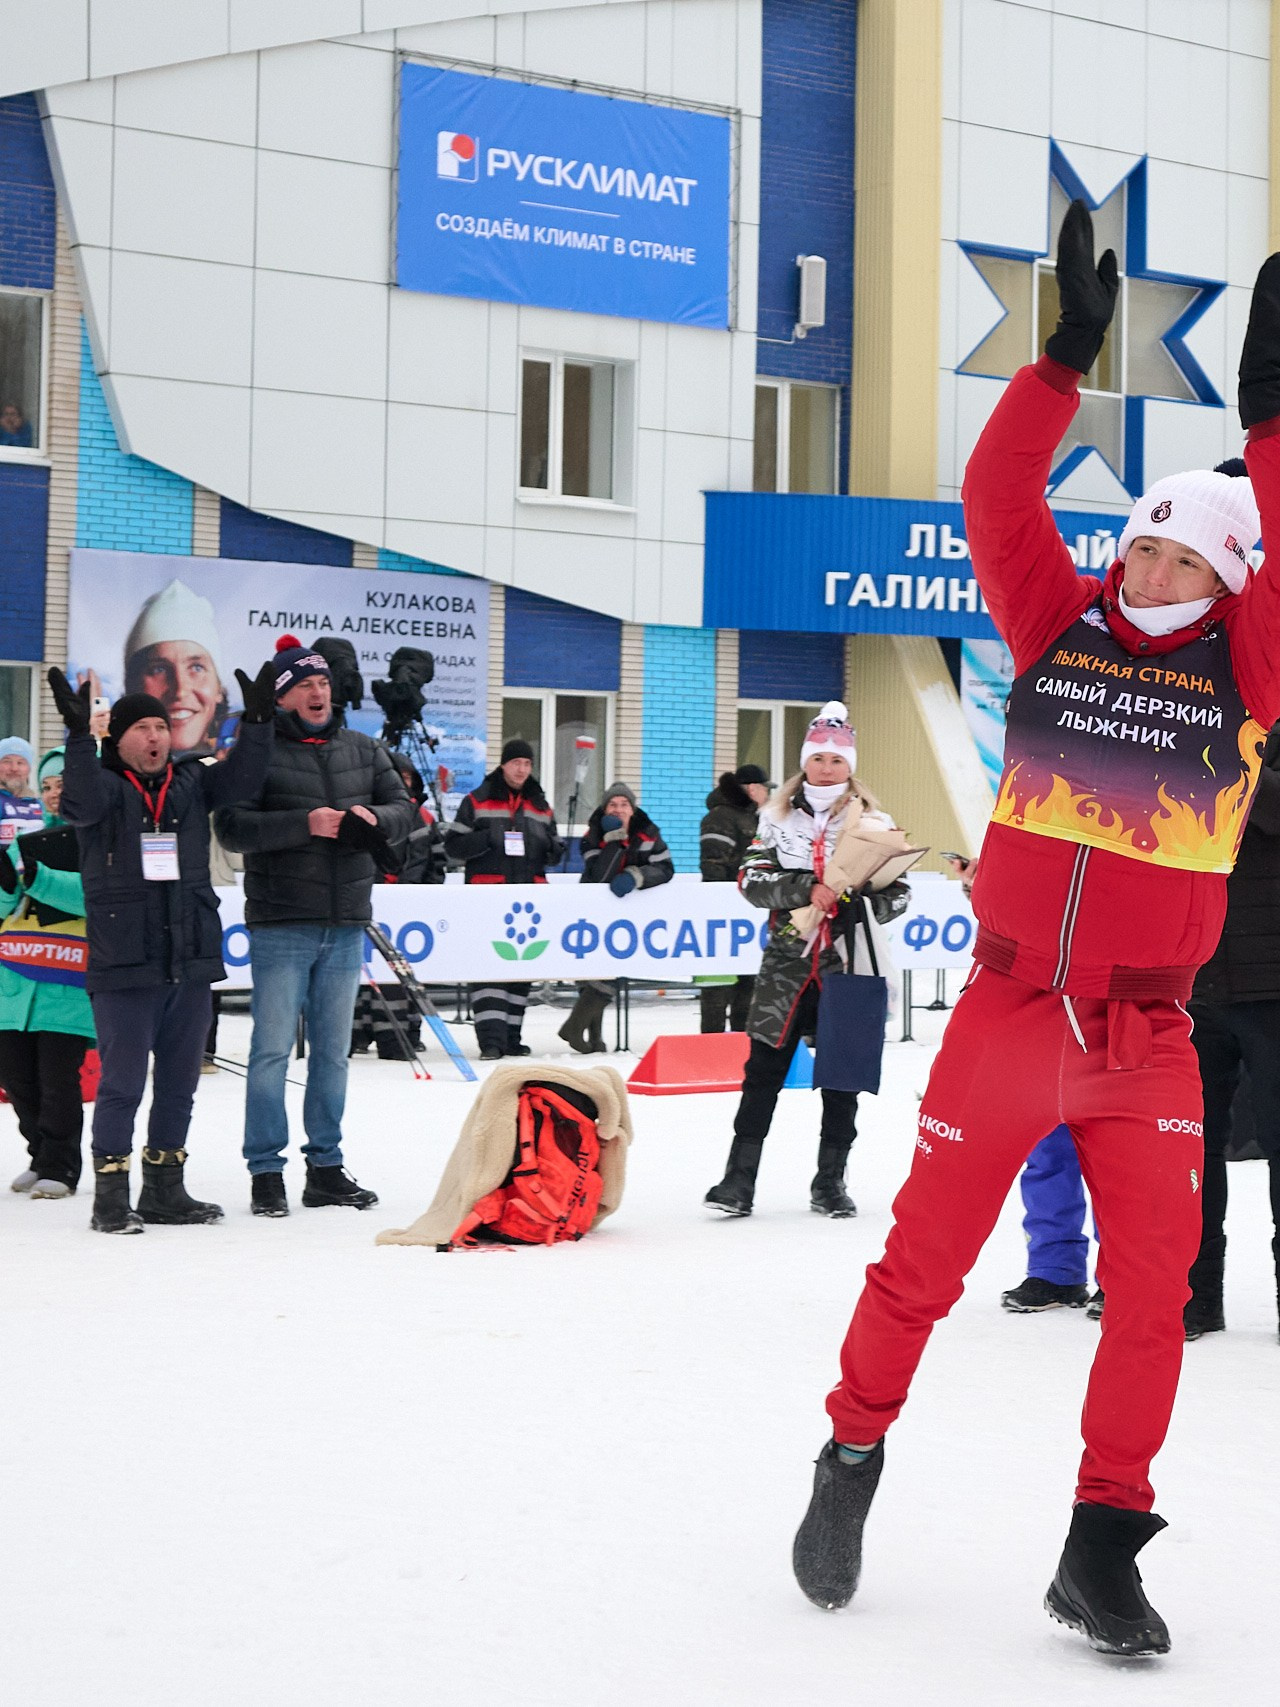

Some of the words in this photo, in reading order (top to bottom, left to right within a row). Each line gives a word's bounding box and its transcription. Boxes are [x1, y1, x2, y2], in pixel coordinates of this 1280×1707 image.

[486, 147, 698, 207] РУСКЛИМАТ
[435, 212, 530, 242] СОЗДАЁМ
[533, 227, 610, 253] КЛИМАТ
[613, 237, 627, 256] В
[629, 240, 697, 266] СТРАНЕ
[366, 591, 477, 614] КУЛАКОВА
[248, 610, 334, 632] ГАЛИНА
[340, 616, 477, 640] АЛЕКСЕЕВНА
[361, 651, 380, 663] НА
[384, 652, 476, 667] ОИАДАХ
[1051, 649, 1134, 680] ЛЫЖНАЯ
[1138, 667, 1215, 696] СТРАНА
[1035, 676, 1107, 706] САМЫЙ
[1111, 691, 1223, 730] ДЕРЗКИЙ
[1057, 710, 1178, 750] ЛЫЖНИК
[0, 942, 84, 964] МУРТИЯ
[917, 1111, 964, 1142] UKOIL
[1157, 1118, 1203, 1138] BOSCO
